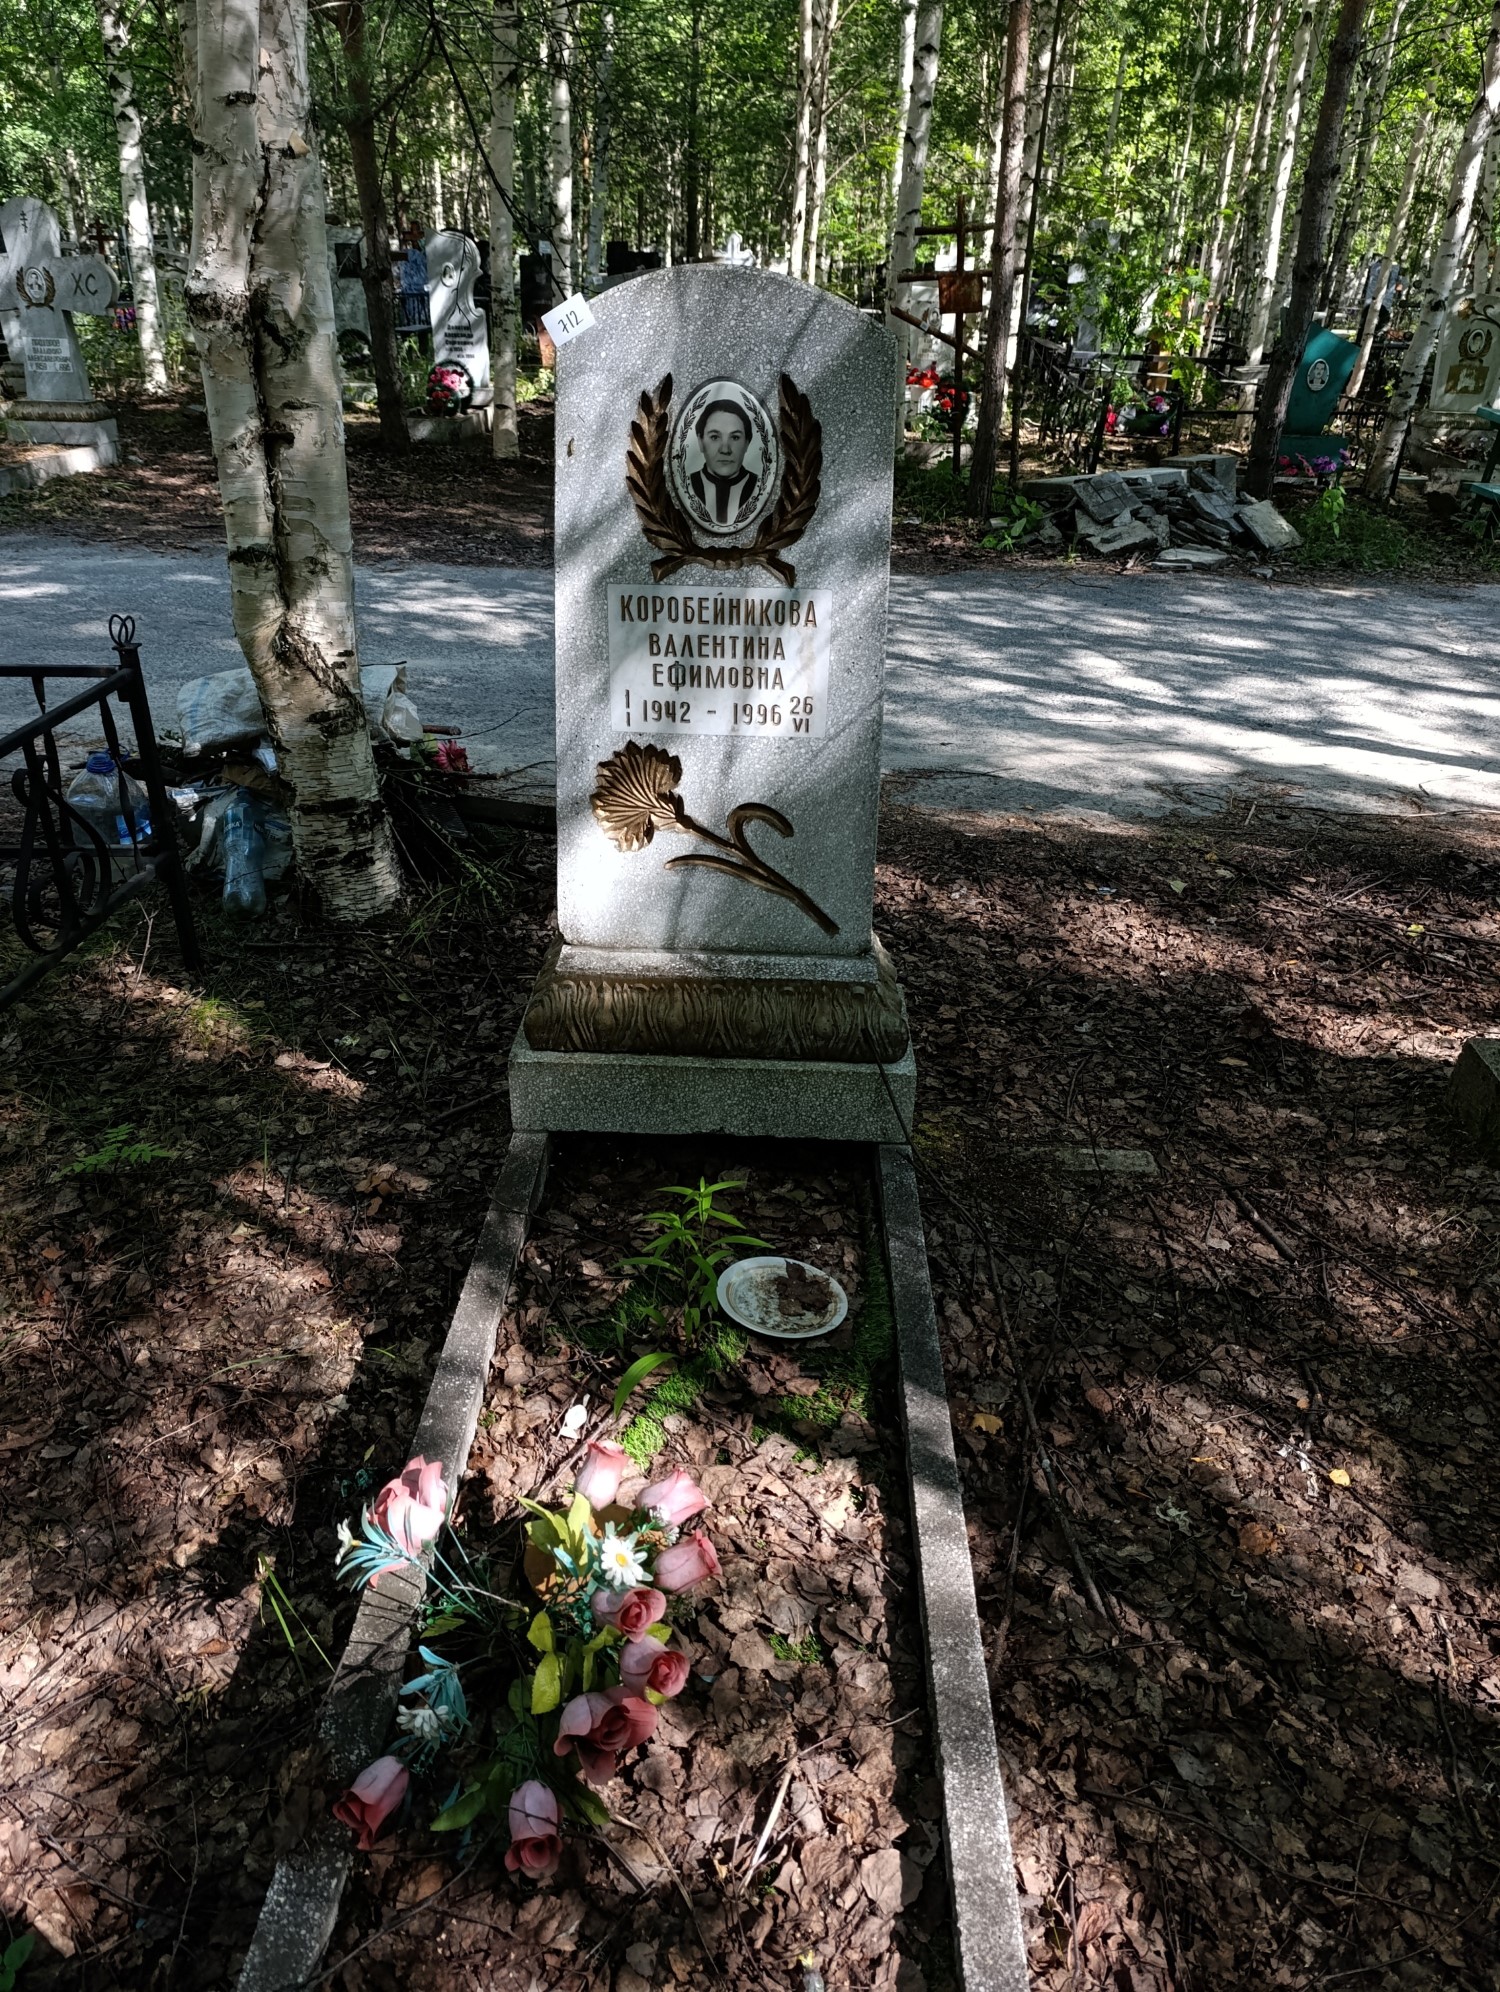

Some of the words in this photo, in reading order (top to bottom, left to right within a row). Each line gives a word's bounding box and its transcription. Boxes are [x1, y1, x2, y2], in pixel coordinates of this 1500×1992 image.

[70, 271, 98, 297] ХС
[557, 310, 585, 334] 712
[620, 592, 818, 628] КОРОБЕЙНИКОВА
[649, 633, 786, 661] ВАЛЕНТИНА
[652, 660, 785, 692] ЕФИМОВНА
[642, 700, 691, 724] 1942
[733, 702, 782, 726] 1996
[789, 696, 815, 716] 26
[792, 718, 811, 733] VI
